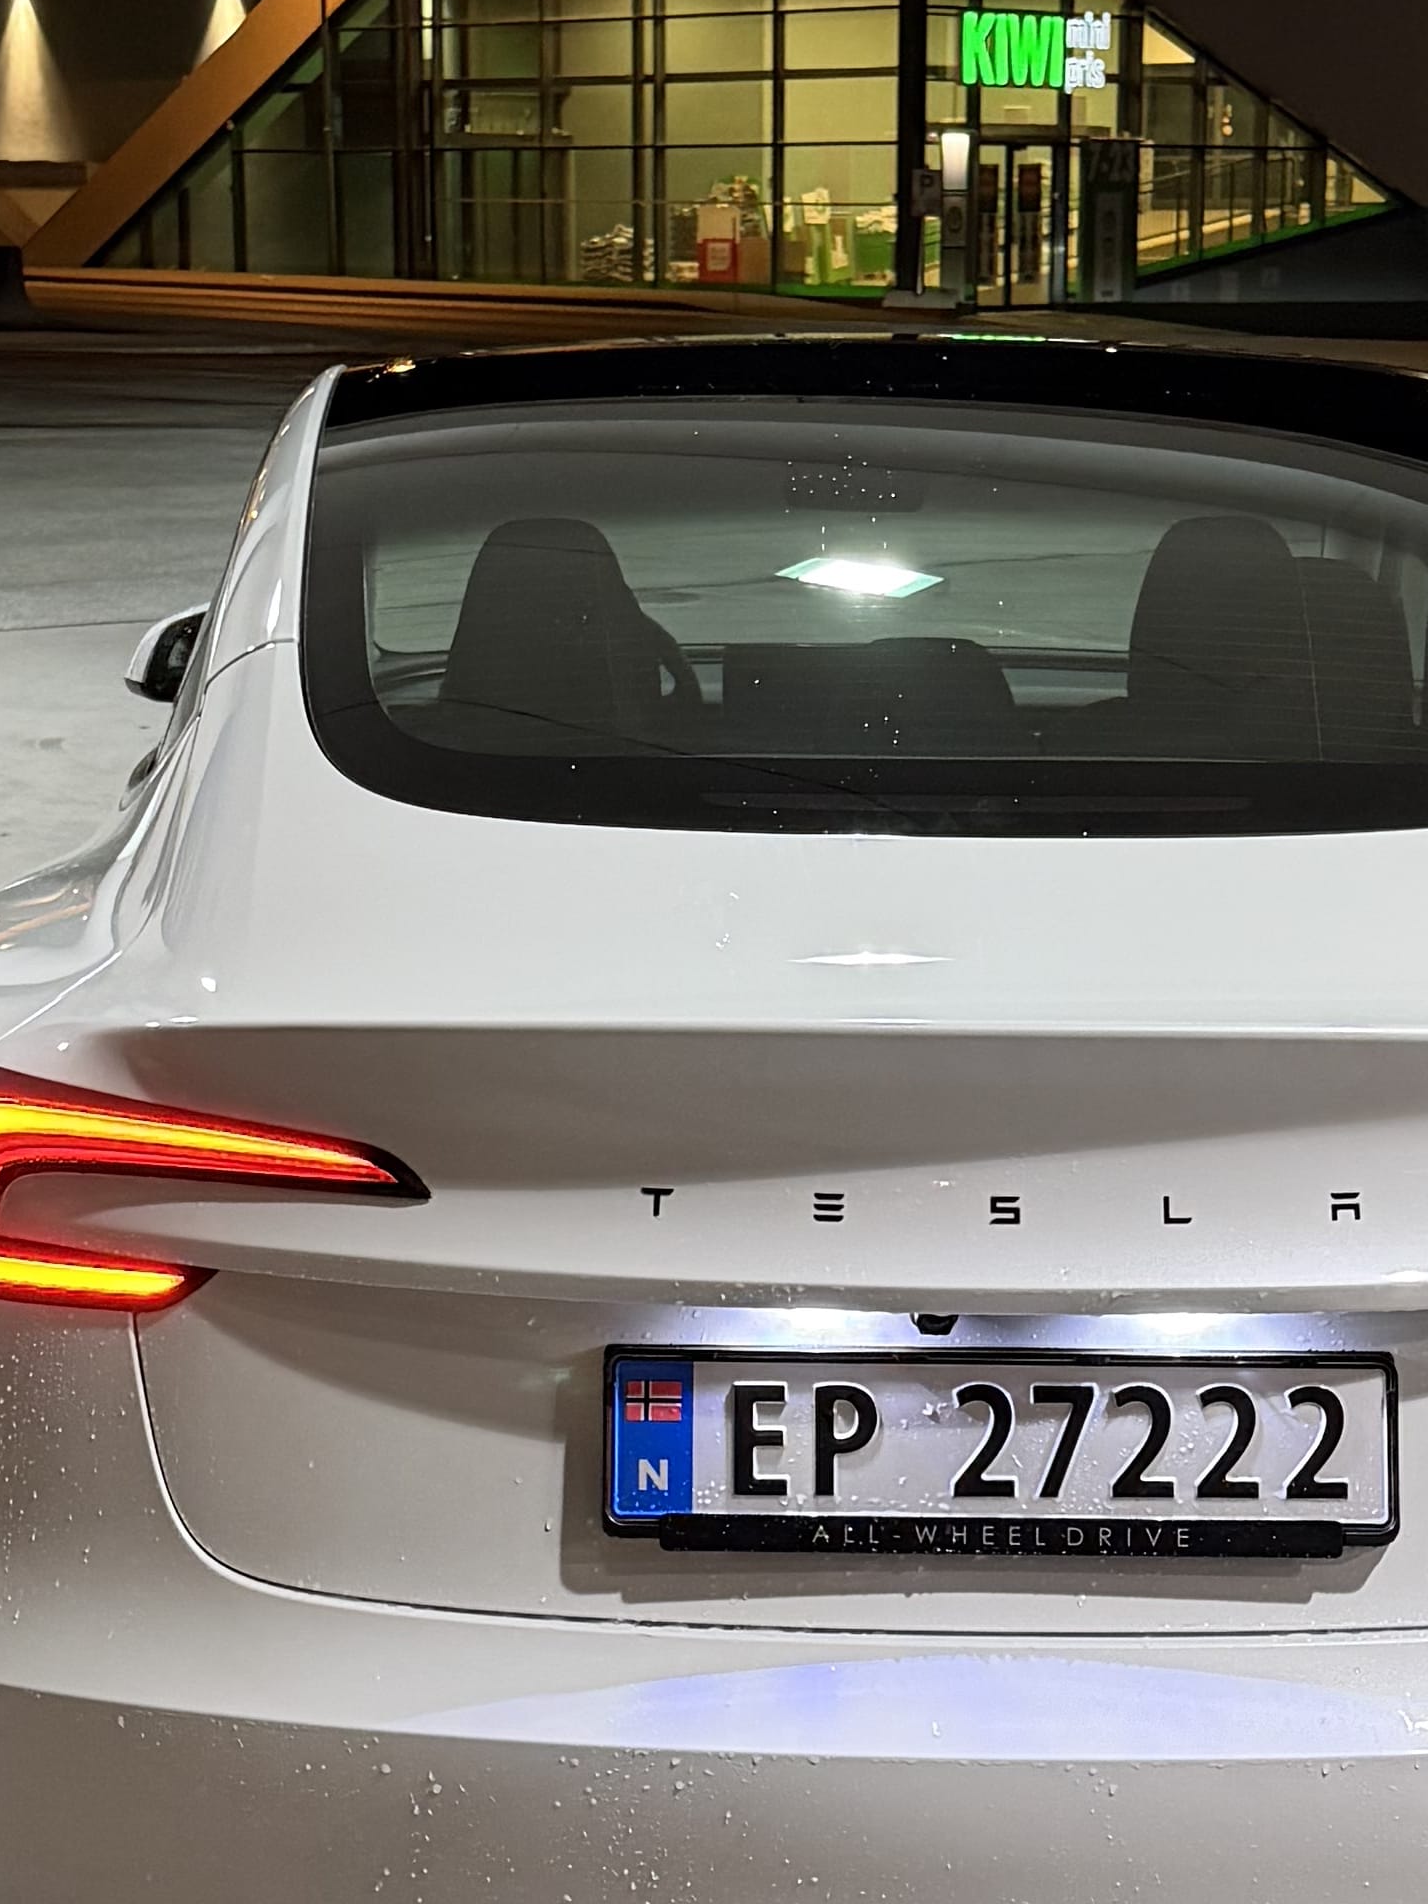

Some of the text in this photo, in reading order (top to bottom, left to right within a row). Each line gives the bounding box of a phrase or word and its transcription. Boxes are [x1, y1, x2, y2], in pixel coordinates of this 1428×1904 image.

[962, 11, 1064, 87] KIWI
[1066, 11, 1112, 50] mini
[1064, 49, 1106, 95] pris
[641, 1187, 1361, 1225] TESLA
[732, 1383, 1351, 1499] EP 27222
[639, 1459, 669, 1491] N
[812, 1525, 1191, 1548] ALL-WHEEL DRIVE
